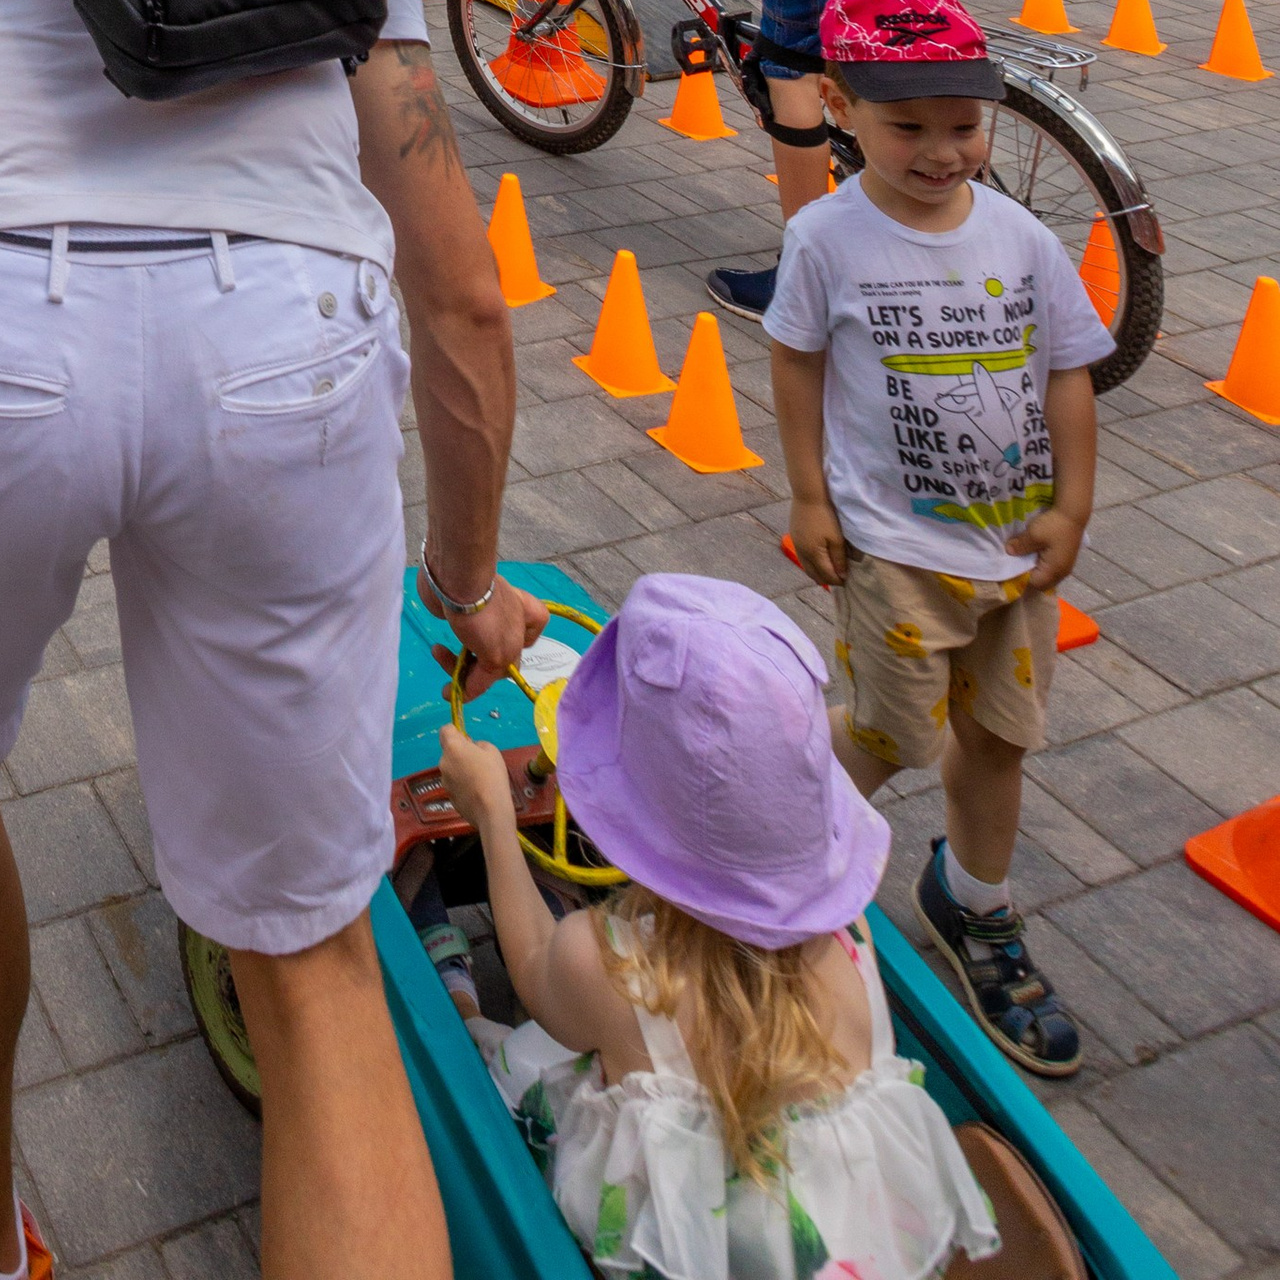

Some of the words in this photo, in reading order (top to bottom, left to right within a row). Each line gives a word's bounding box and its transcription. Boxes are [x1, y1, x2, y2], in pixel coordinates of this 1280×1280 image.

[875, 8, 951, 29] Reebok
[867, 304, 923, 327] LET'S
[873, 330, 901, 347] ON
[907, 331, 924, 349] A
[886, 374, 914, 402] BE
[1021, 371, 1034, 394] A
[893, 423, 949, 455] LIKE
[958, 433, 977, 455] A
[904, 473, 957, 497] UND
